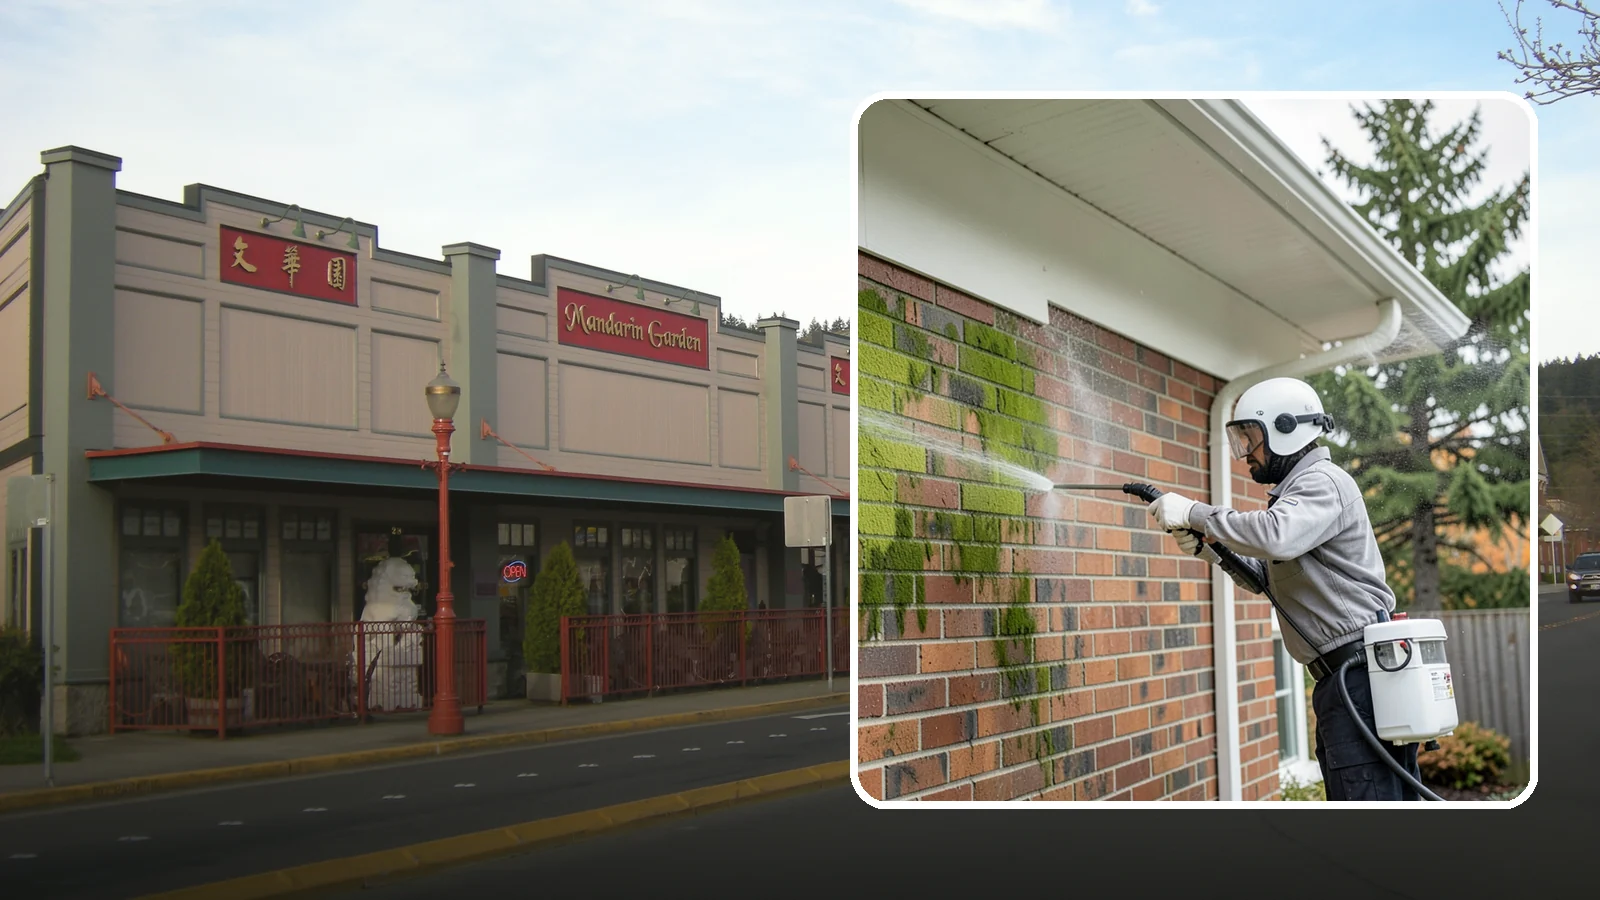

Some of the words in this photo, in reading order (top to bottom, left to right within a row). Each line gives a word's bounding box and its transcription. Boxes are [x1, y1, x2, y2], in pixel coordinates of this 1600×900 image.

[231, 235, 346, 291] 文華園
[564, 302, 644, 341] Mandarin
[647, 320, 702, 352] Garden
[834, 363, 847, 387] 文
[503, 565, 527, 579] OPEN
